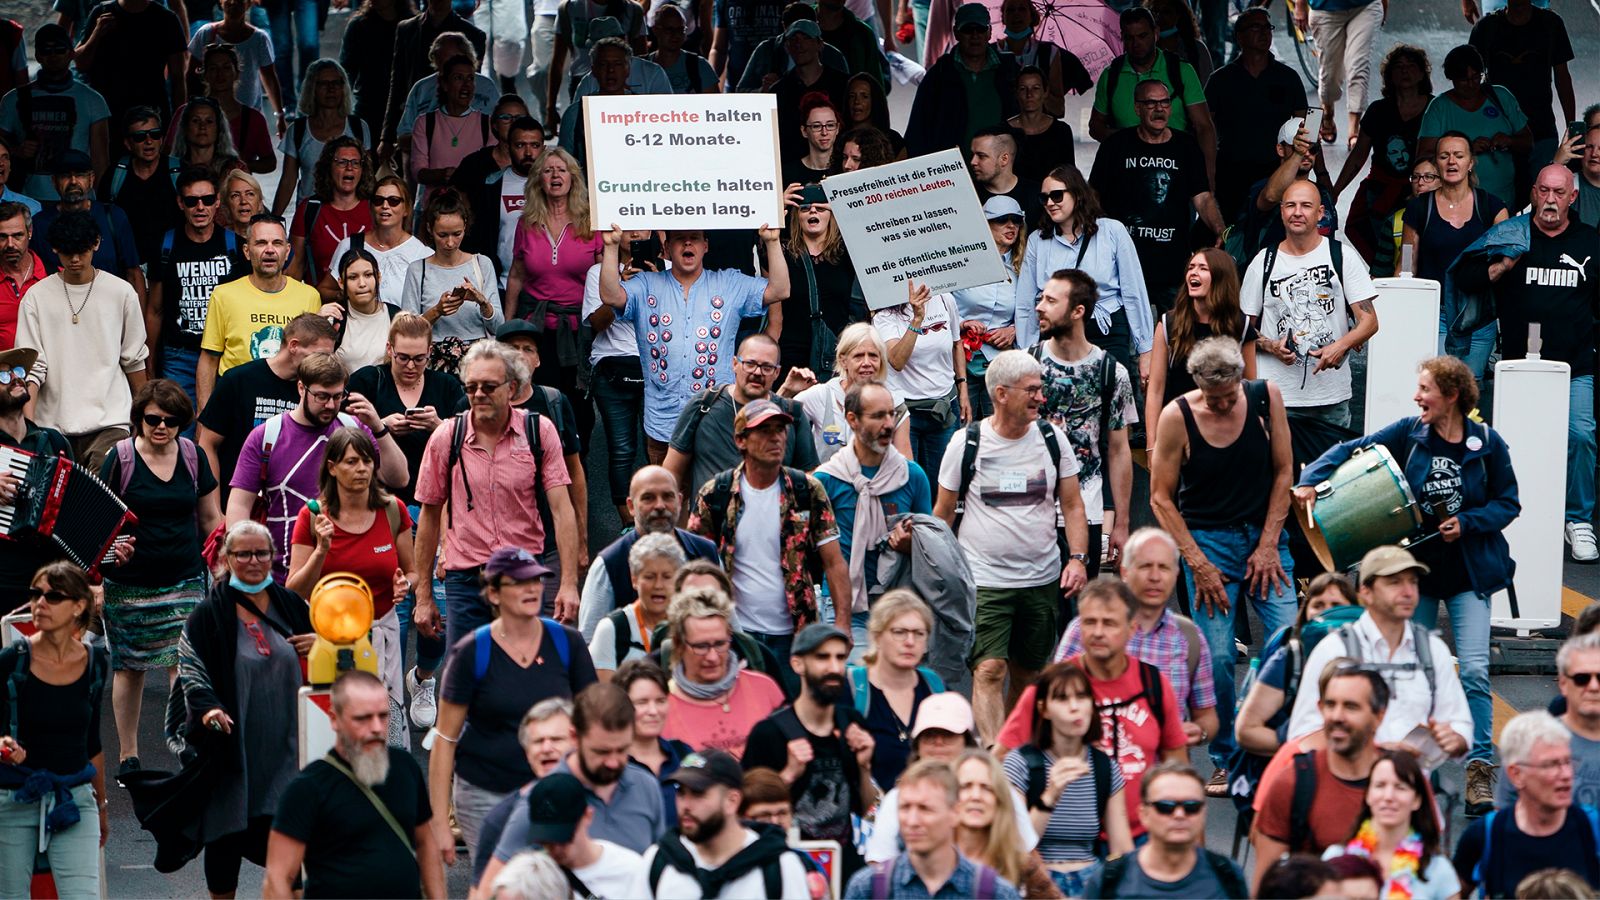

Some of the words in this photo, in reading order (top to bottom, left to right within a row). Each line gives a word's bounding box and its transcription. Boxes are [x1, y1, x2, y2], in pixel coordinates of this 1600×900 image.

[601, 111, 700, 126] Impfrechte
[705, 110, 762, 122] halten
[625, 133, 664, 146] 6-12
[669, 133, 741, 146] Monate.
[1125, 158, 1137, 169] IN
[1139, 157, 1179, 170] CAROL
[598, 180, 711, 193] Grundrechte
[717, 179, 774, 191] halten
[829, 177, 897, 202] „Pressefreiheit
[898, 173, 911, 184] ist
[911, 170, 926, 180] die
[927, 161, 963, 176] Freiheit
[847, 200, 865, 209] von
[865, 193, 883, 205] 200
[884, 187, 919, 201] reichen
[919, 179, 955, 192] Leuten,
[618, 203, 646, 216] ein
[652, 203, 706, 216] Leben
[712, 202, 756, 217] lang.
[865, 216, 911, 233] schreiben
[912, 213, 923, 222] zu
[923, 206, 958, 220] lassen,
[881, 233, 901, 243] was
[902, 229, 917, 239] sie
[917, 222, 952, 236] wollen,
[1138, 227, 1175, 239] TRUST
[865, 266, 881, 275] um
[881, 261, 897, 271] die
[898, 249, 948, 267] öffentliche
[948, 241, 988, 256] Meinung
[181, 276, 219, 287] GLAUBEN
[893, 274, 905, 283] zu
[1525, 267, 1579, 287] PUMA
